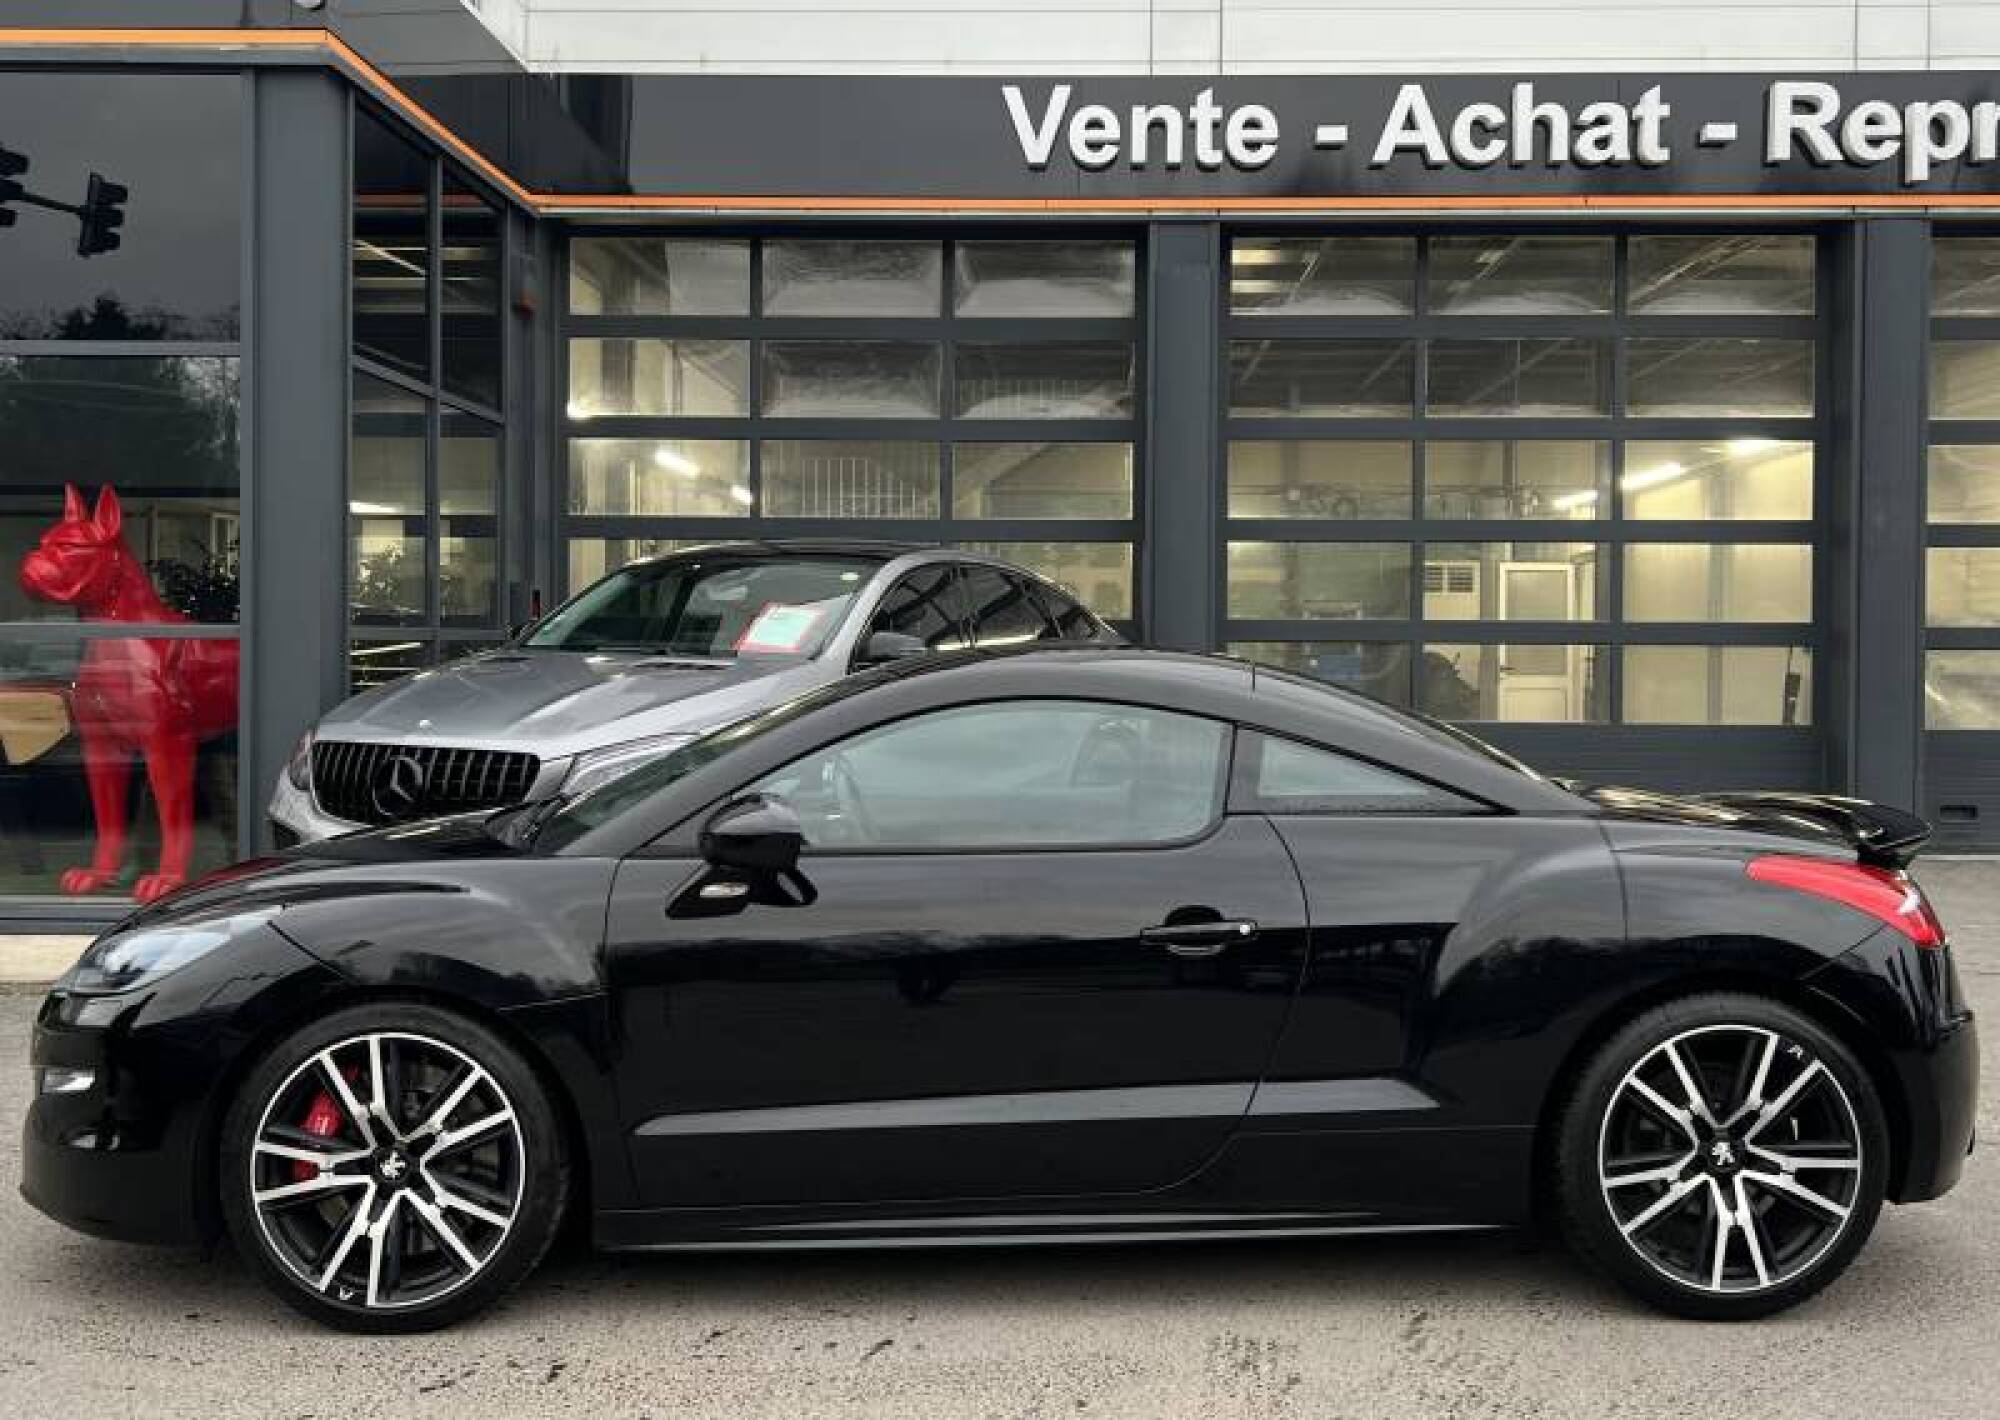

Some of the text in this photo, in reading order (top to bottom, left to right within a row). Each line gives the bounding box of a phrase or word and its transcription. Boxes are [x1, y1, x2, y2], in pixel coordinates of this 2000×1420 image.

[1002, 84, 1278, 164] Vente
[1314, 124, 1348, 143] -
[1372, 82, 1671, 164] Achat
[1701, 122, 1738, 142] -
